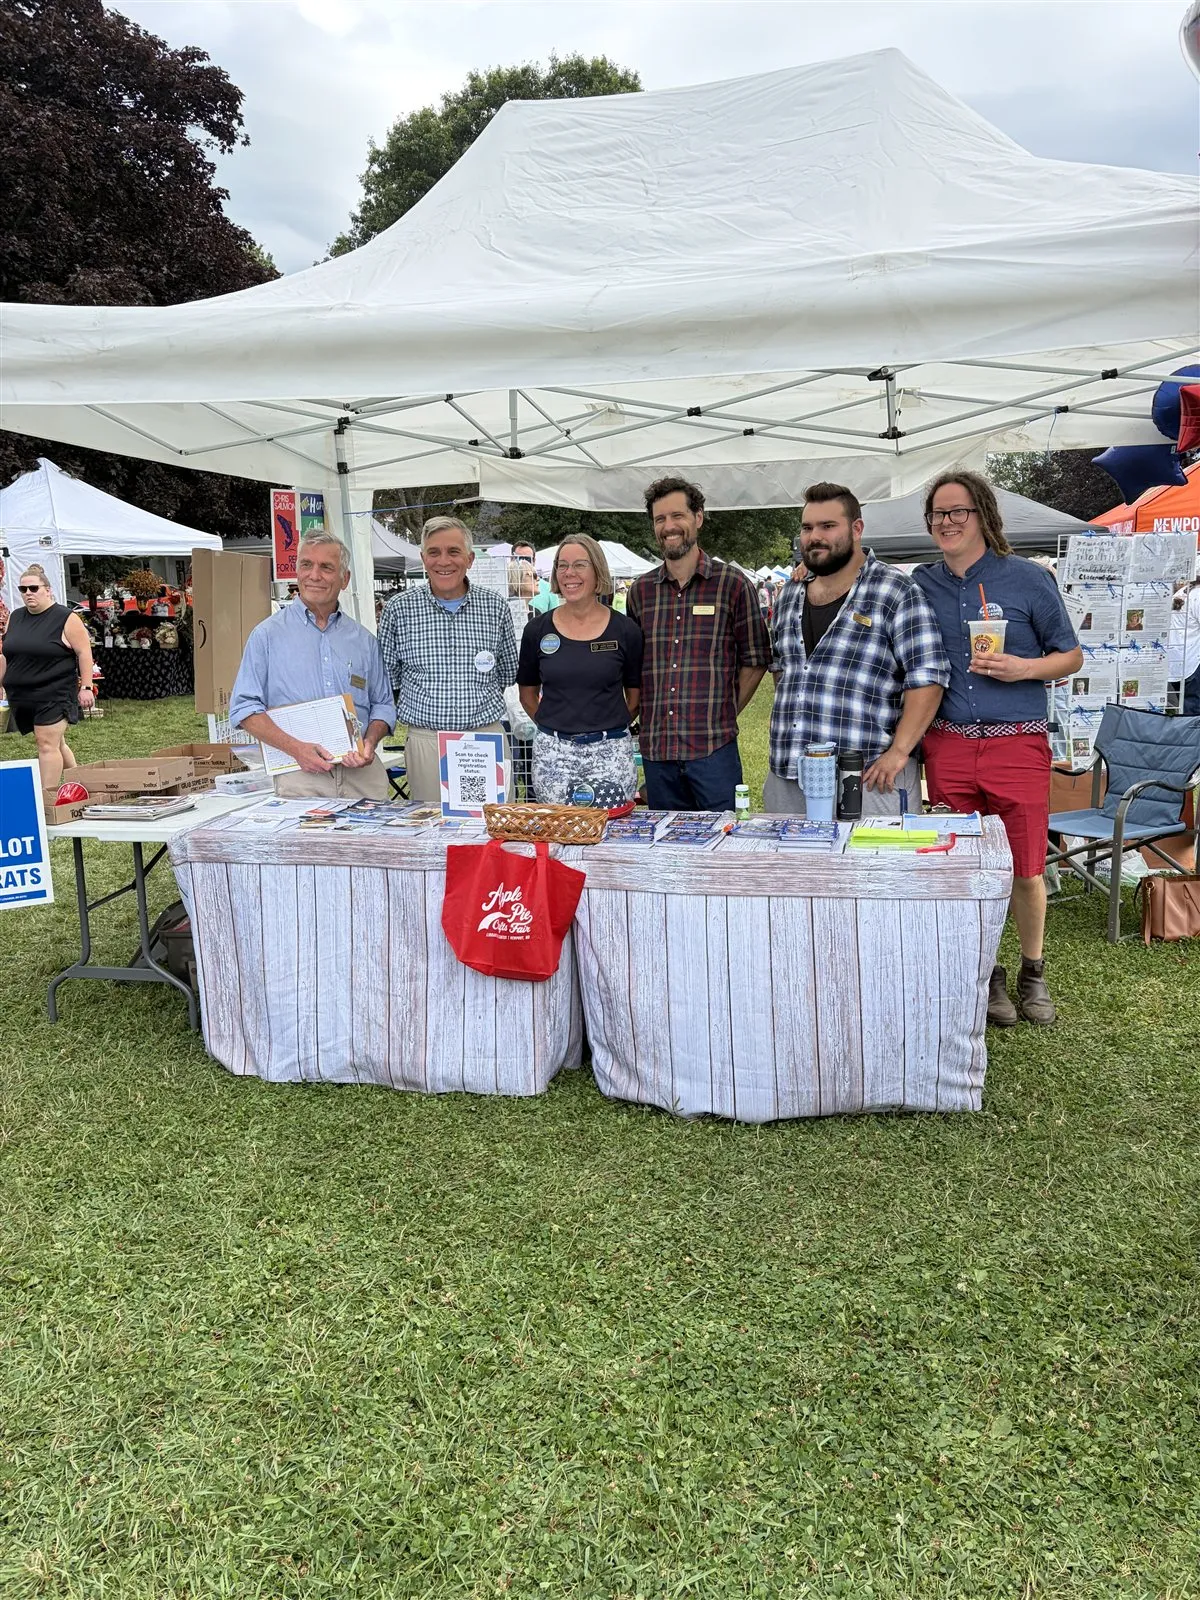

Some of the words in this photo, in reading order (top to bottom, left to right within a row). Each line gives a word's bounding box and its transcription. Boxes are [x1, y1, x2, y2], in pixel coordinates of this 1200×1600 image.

[274, 494, 289, 502] CHRIS
[274, 502, 296, 511] SALMON
[1153, 516, 1200, 532] NEWPO
[276, 563, 289, 572] FOR
[0, 836, 35, 858] LOT
[0, 867, 42, 889] ATS
[507, 902, 533, 925] Pie
[509, 922, 531, 933] Fair
